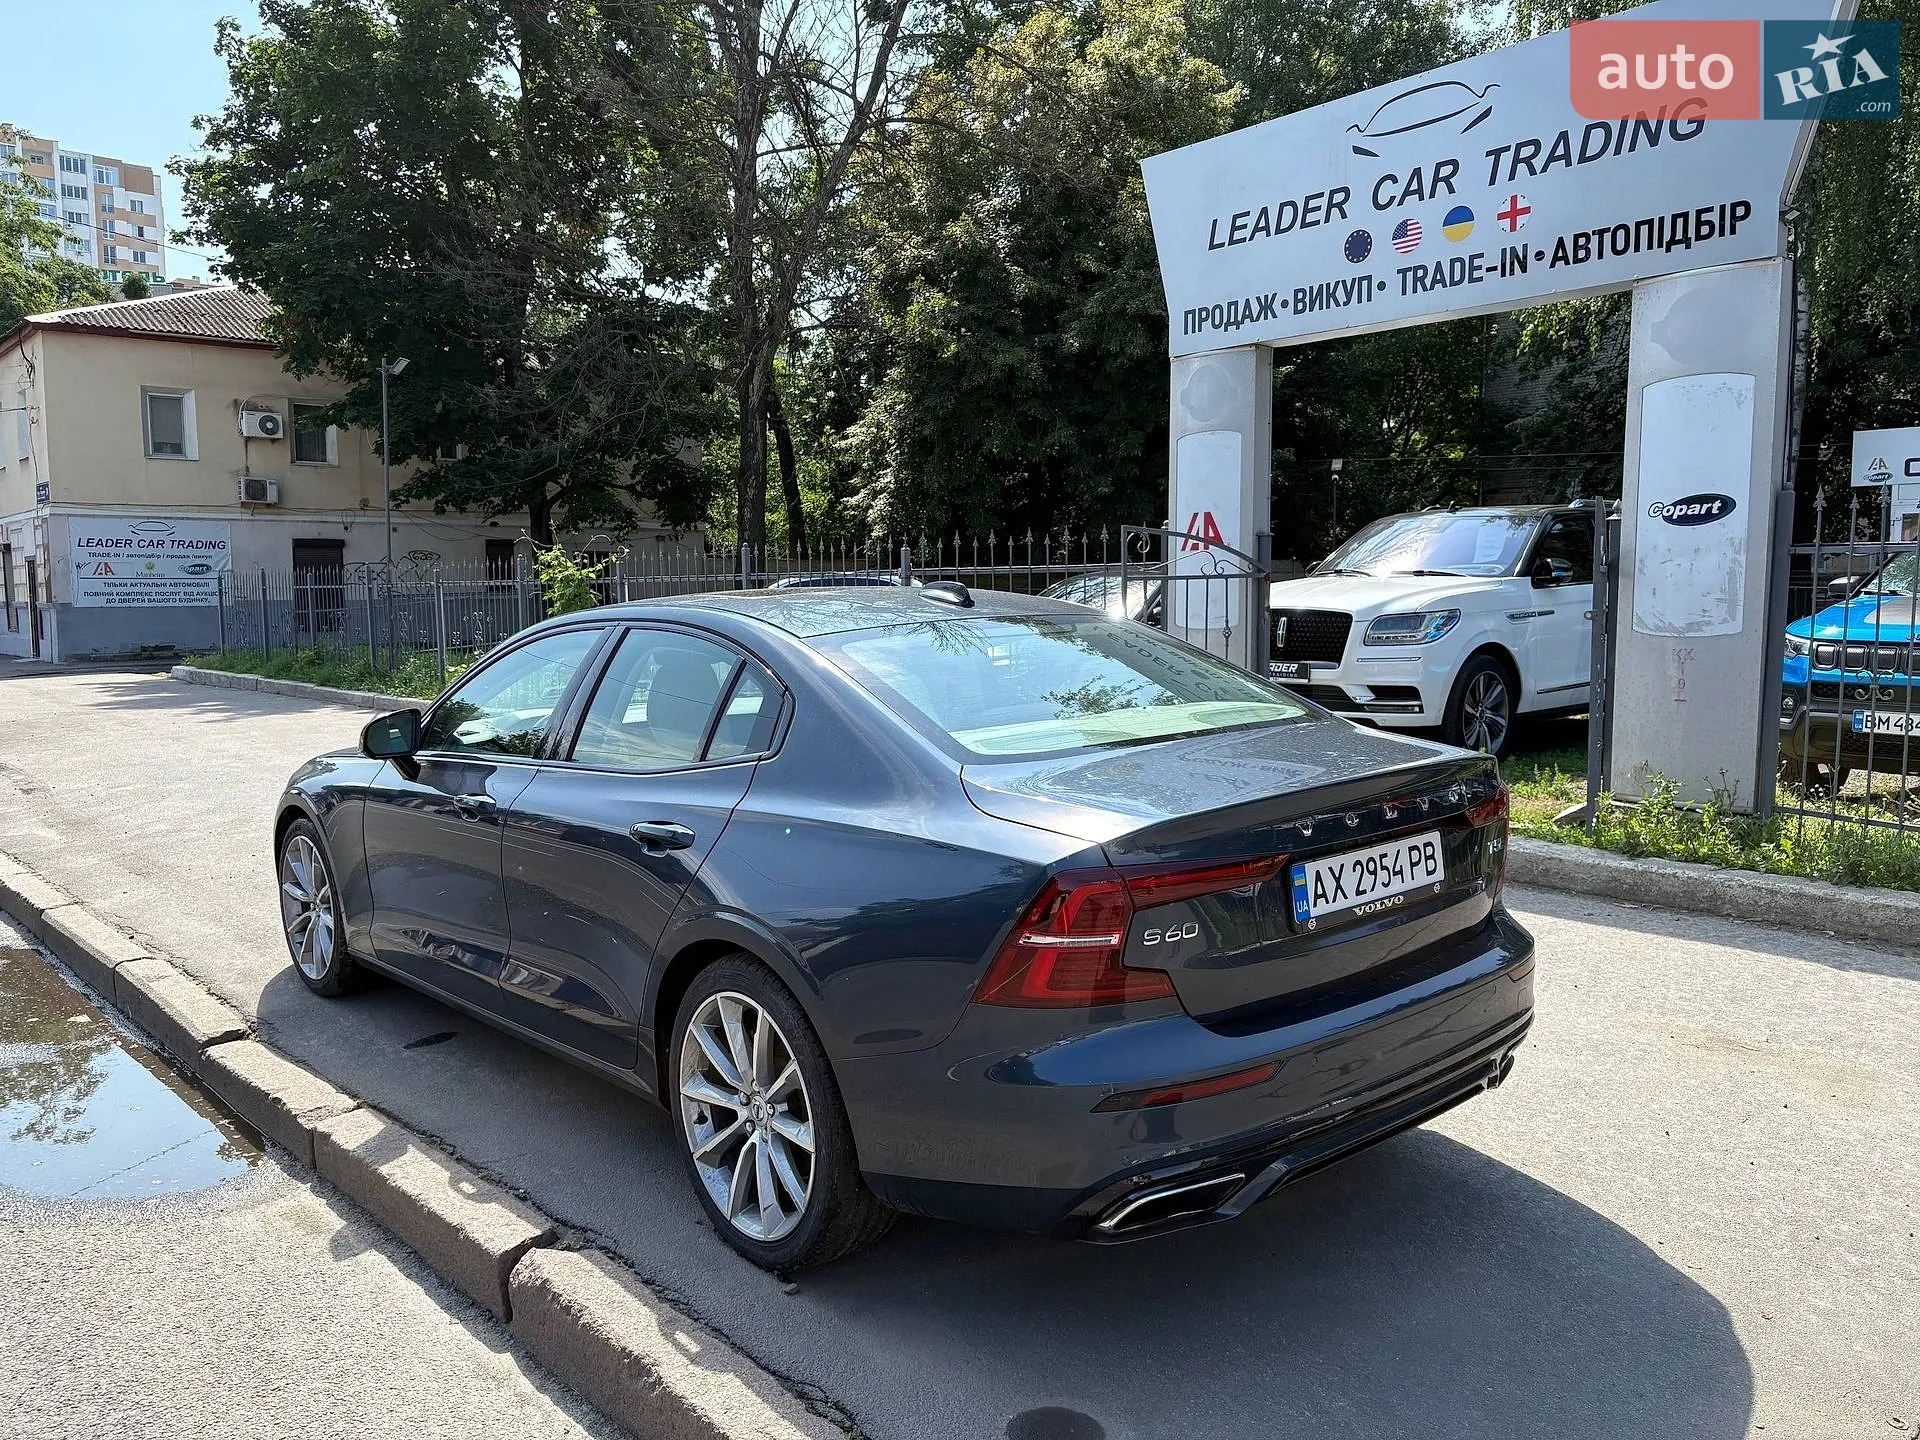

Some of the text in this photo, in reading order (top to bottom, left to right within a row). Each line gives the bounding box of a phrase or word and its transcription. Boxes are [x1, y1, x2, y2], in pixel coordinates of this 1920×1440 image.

[1207, 97, 1709, 251] LEADER CAR TRADING
[1183, 199, 1752, 335] ПРОДАЖ ВИКУП TRADE-IN АВТОПІДБІР
[1648, 499, 1723, 520] Copart
[77, 537, 227, 550] LEADER CAR TRADING
[178, 564, 207, 575] Copart
[1865, 714, 1891, 731] BM
[1312, 841, 1438, 909] AX 2954 PB
[1297, 902, 1309, 914] UA
[1352, 895, 1405, 917] VOLVO
[1142, 921, 1199, 946] S60
